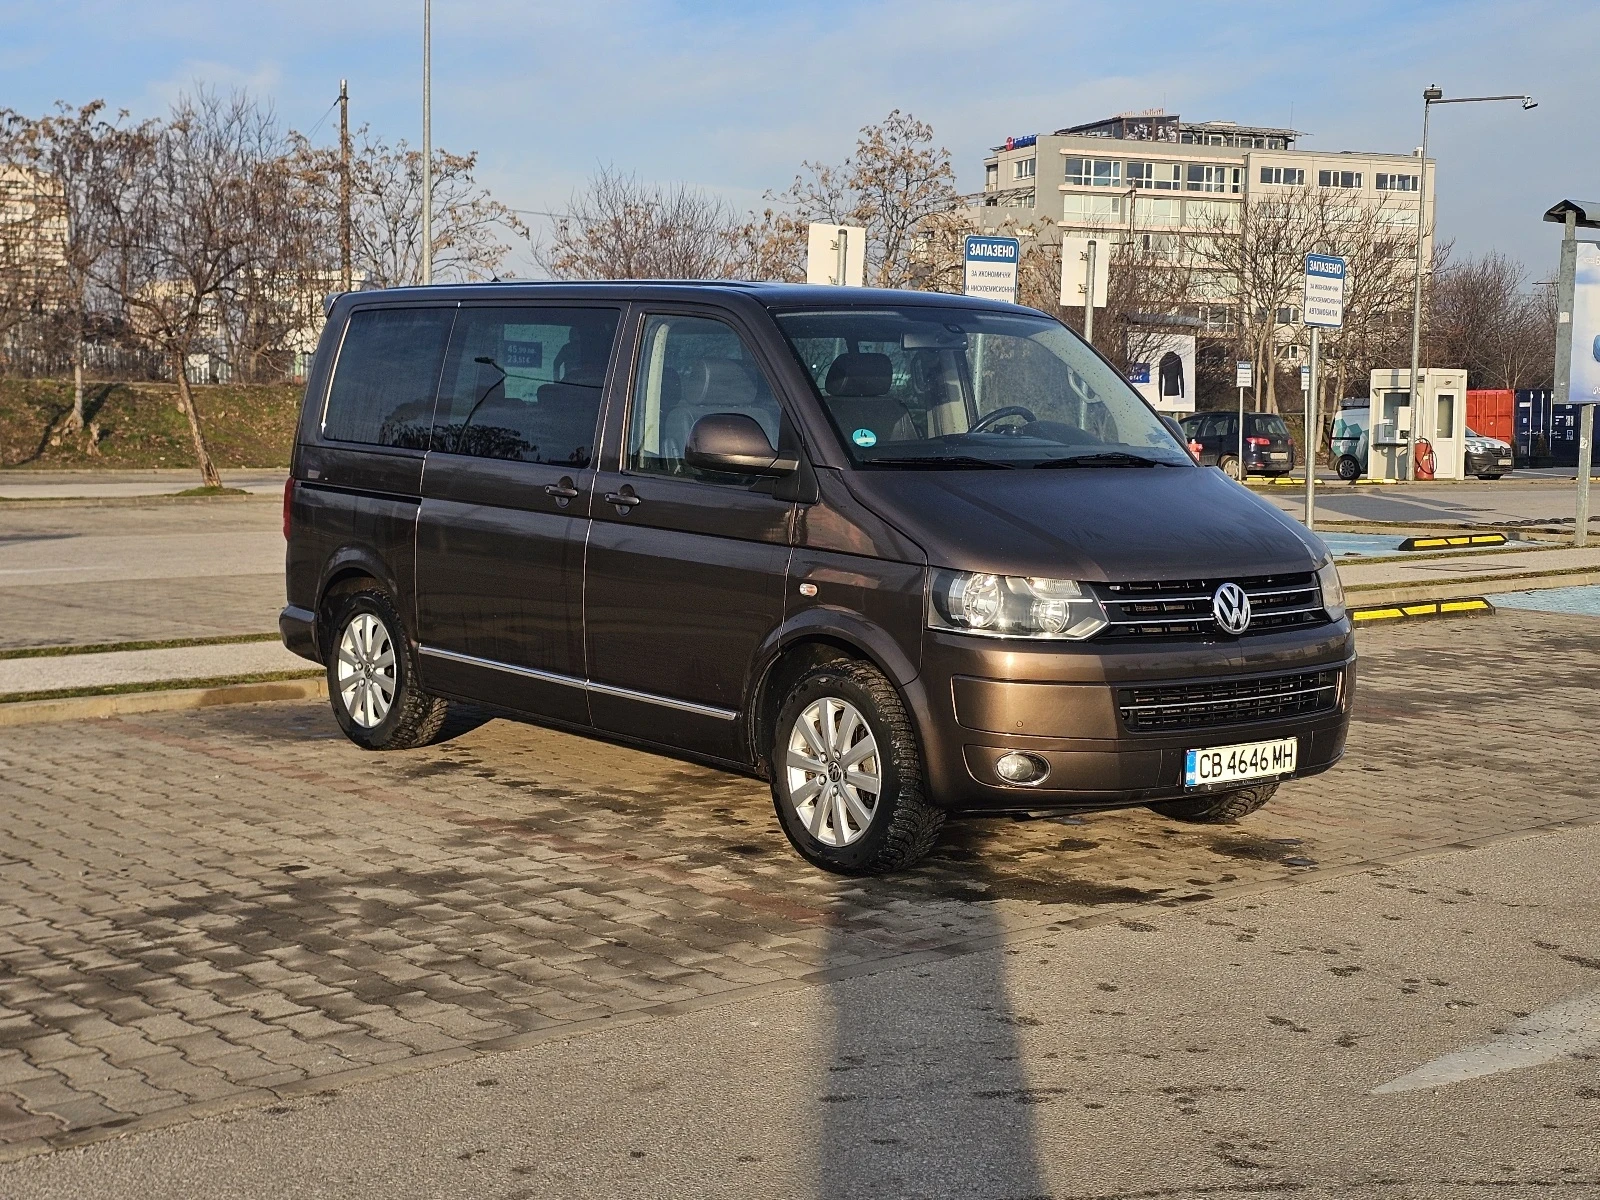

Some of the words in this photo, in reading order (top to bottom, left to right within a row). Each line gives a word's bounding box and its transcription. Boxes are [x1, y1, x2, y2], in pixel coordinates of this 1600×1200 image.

[969, 243, 1015, 257] ЗАПАЗЕНО
[1309, 260, 1342, 274] ЗАПАЗЕНО
[1200, 752, 1222, 778] CB
[1227, 747, 1269, 775] 4646
[1272, 743, 1293, 769] MH
